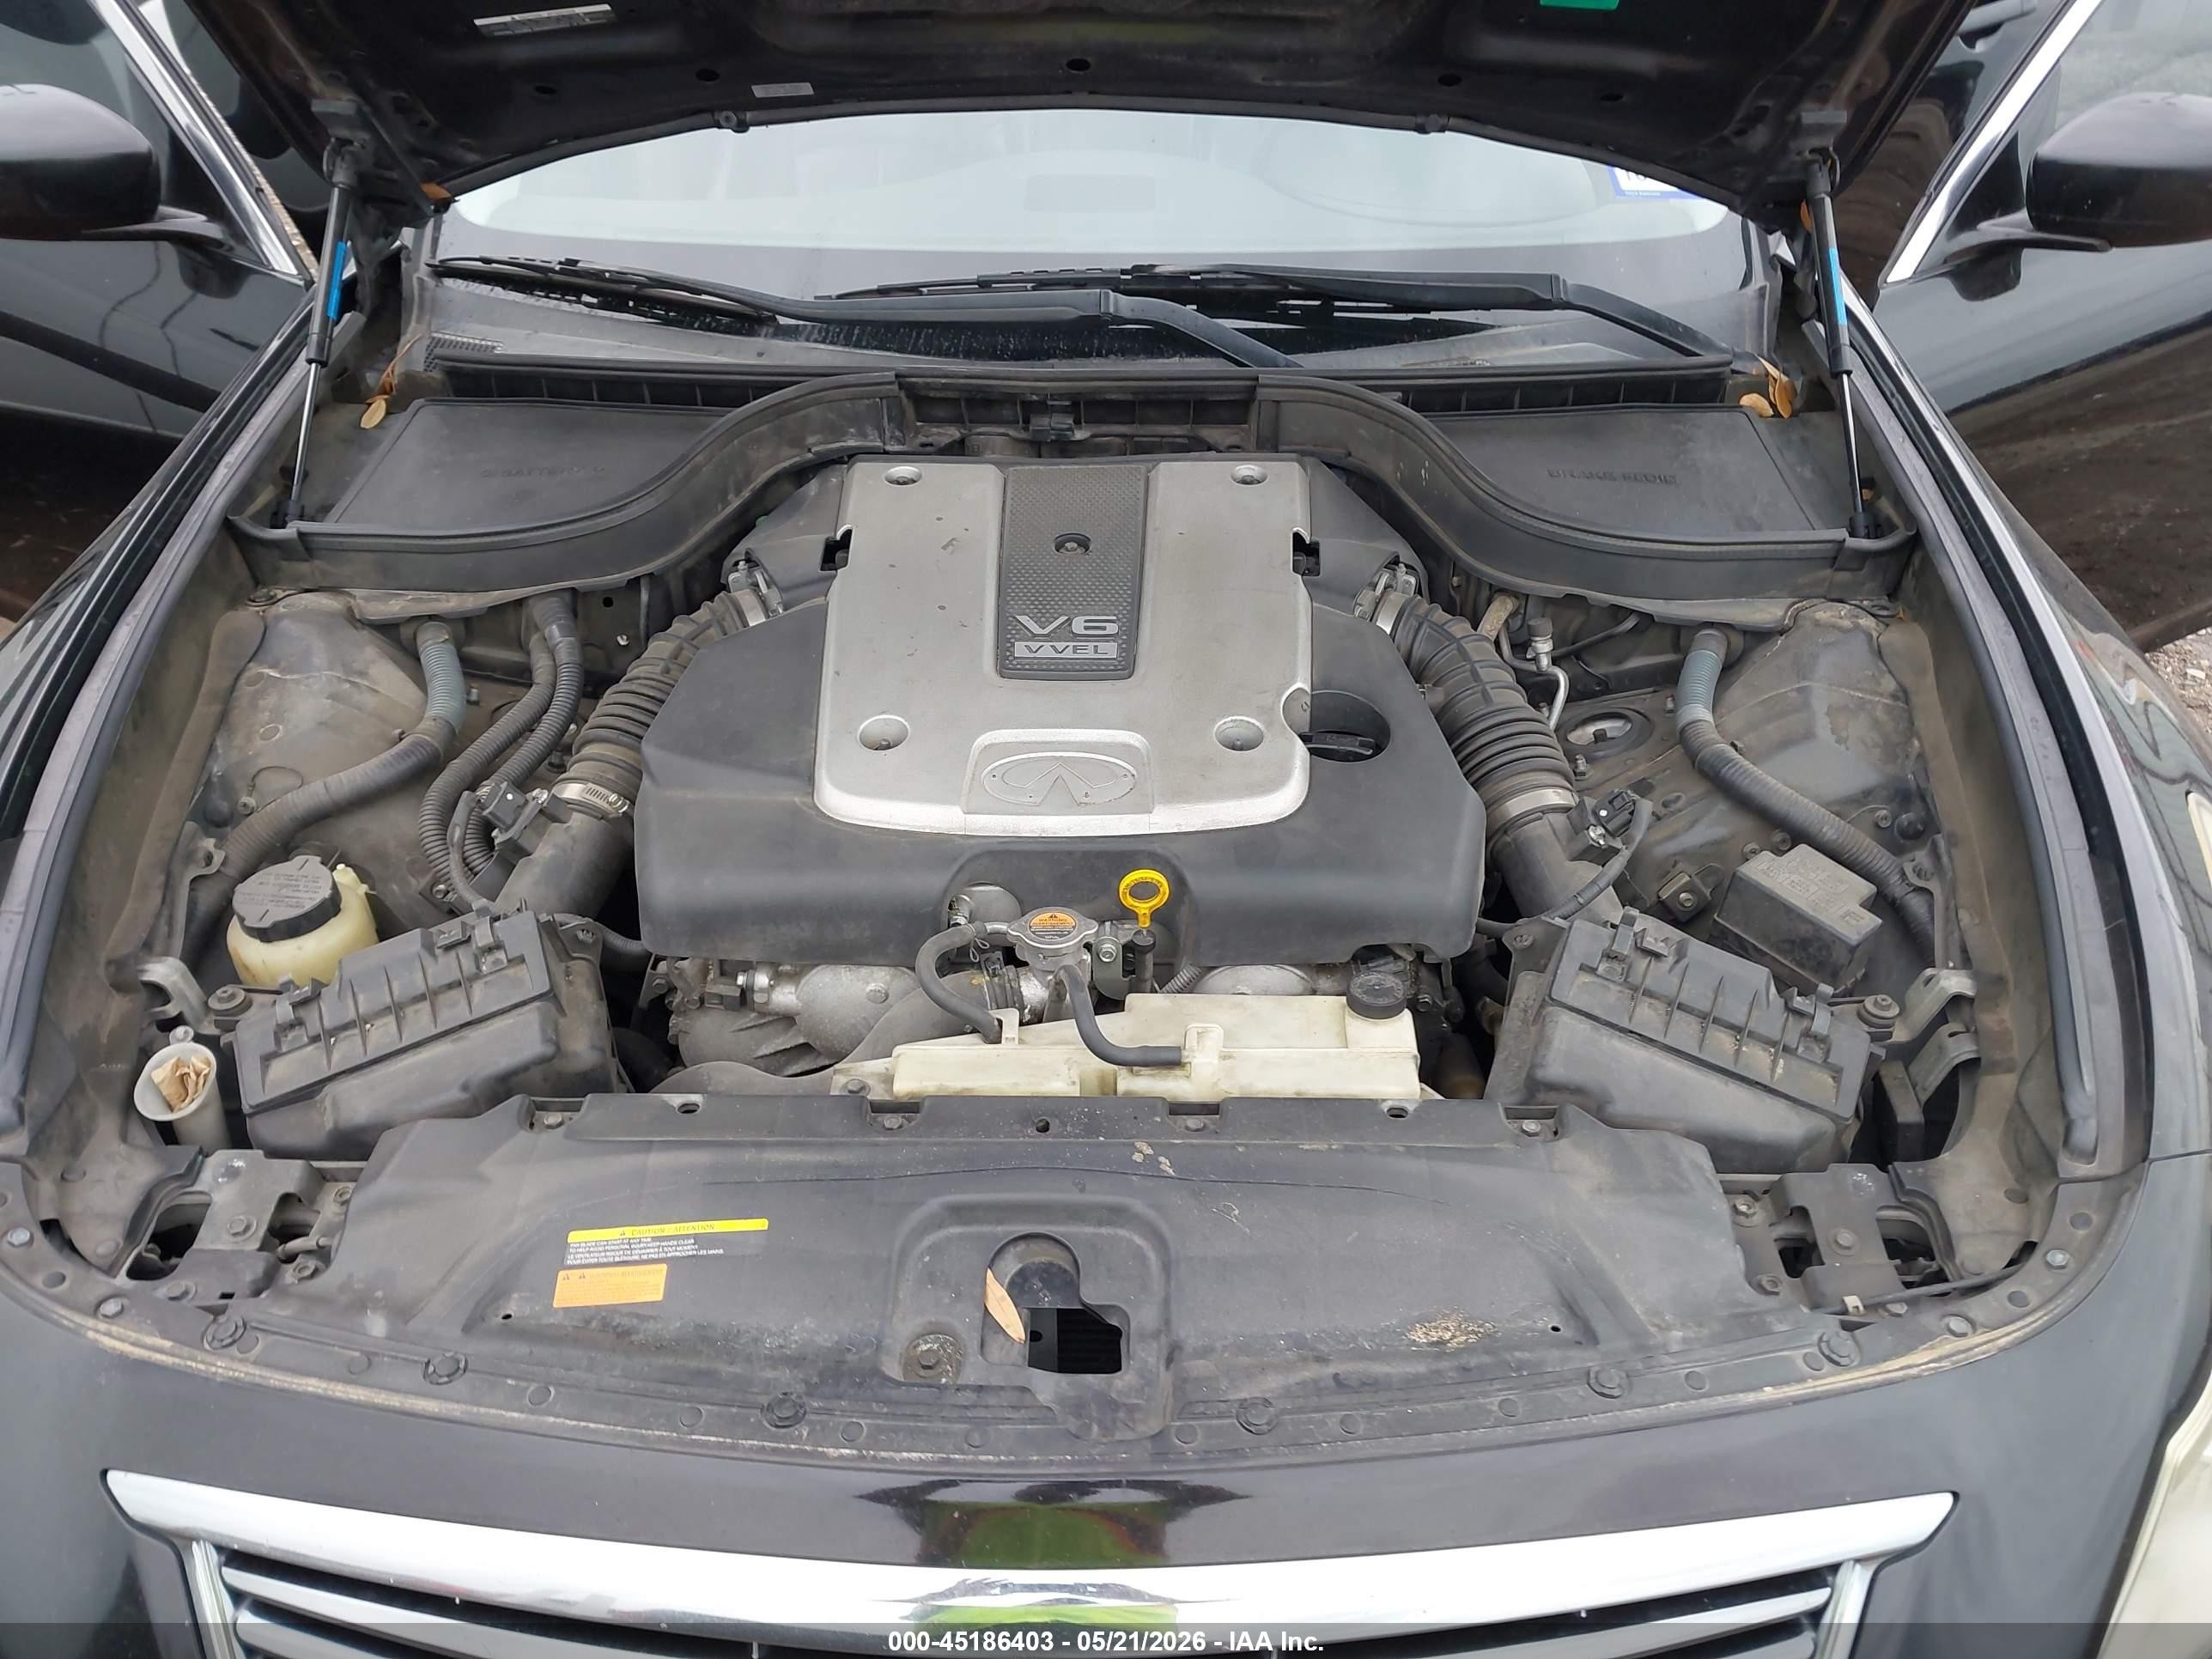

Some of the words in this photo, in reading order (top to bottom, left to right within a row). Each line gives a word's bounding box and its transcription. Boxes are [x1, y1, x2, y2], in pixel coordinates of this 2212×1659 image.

[1015, 615, 1119, 635] V6
[1024, 645, 1109, 654] VVEL
[631, 1227, 665, 1237] CAUTION
[673, 1223, 715, 1232] ATTENTION
